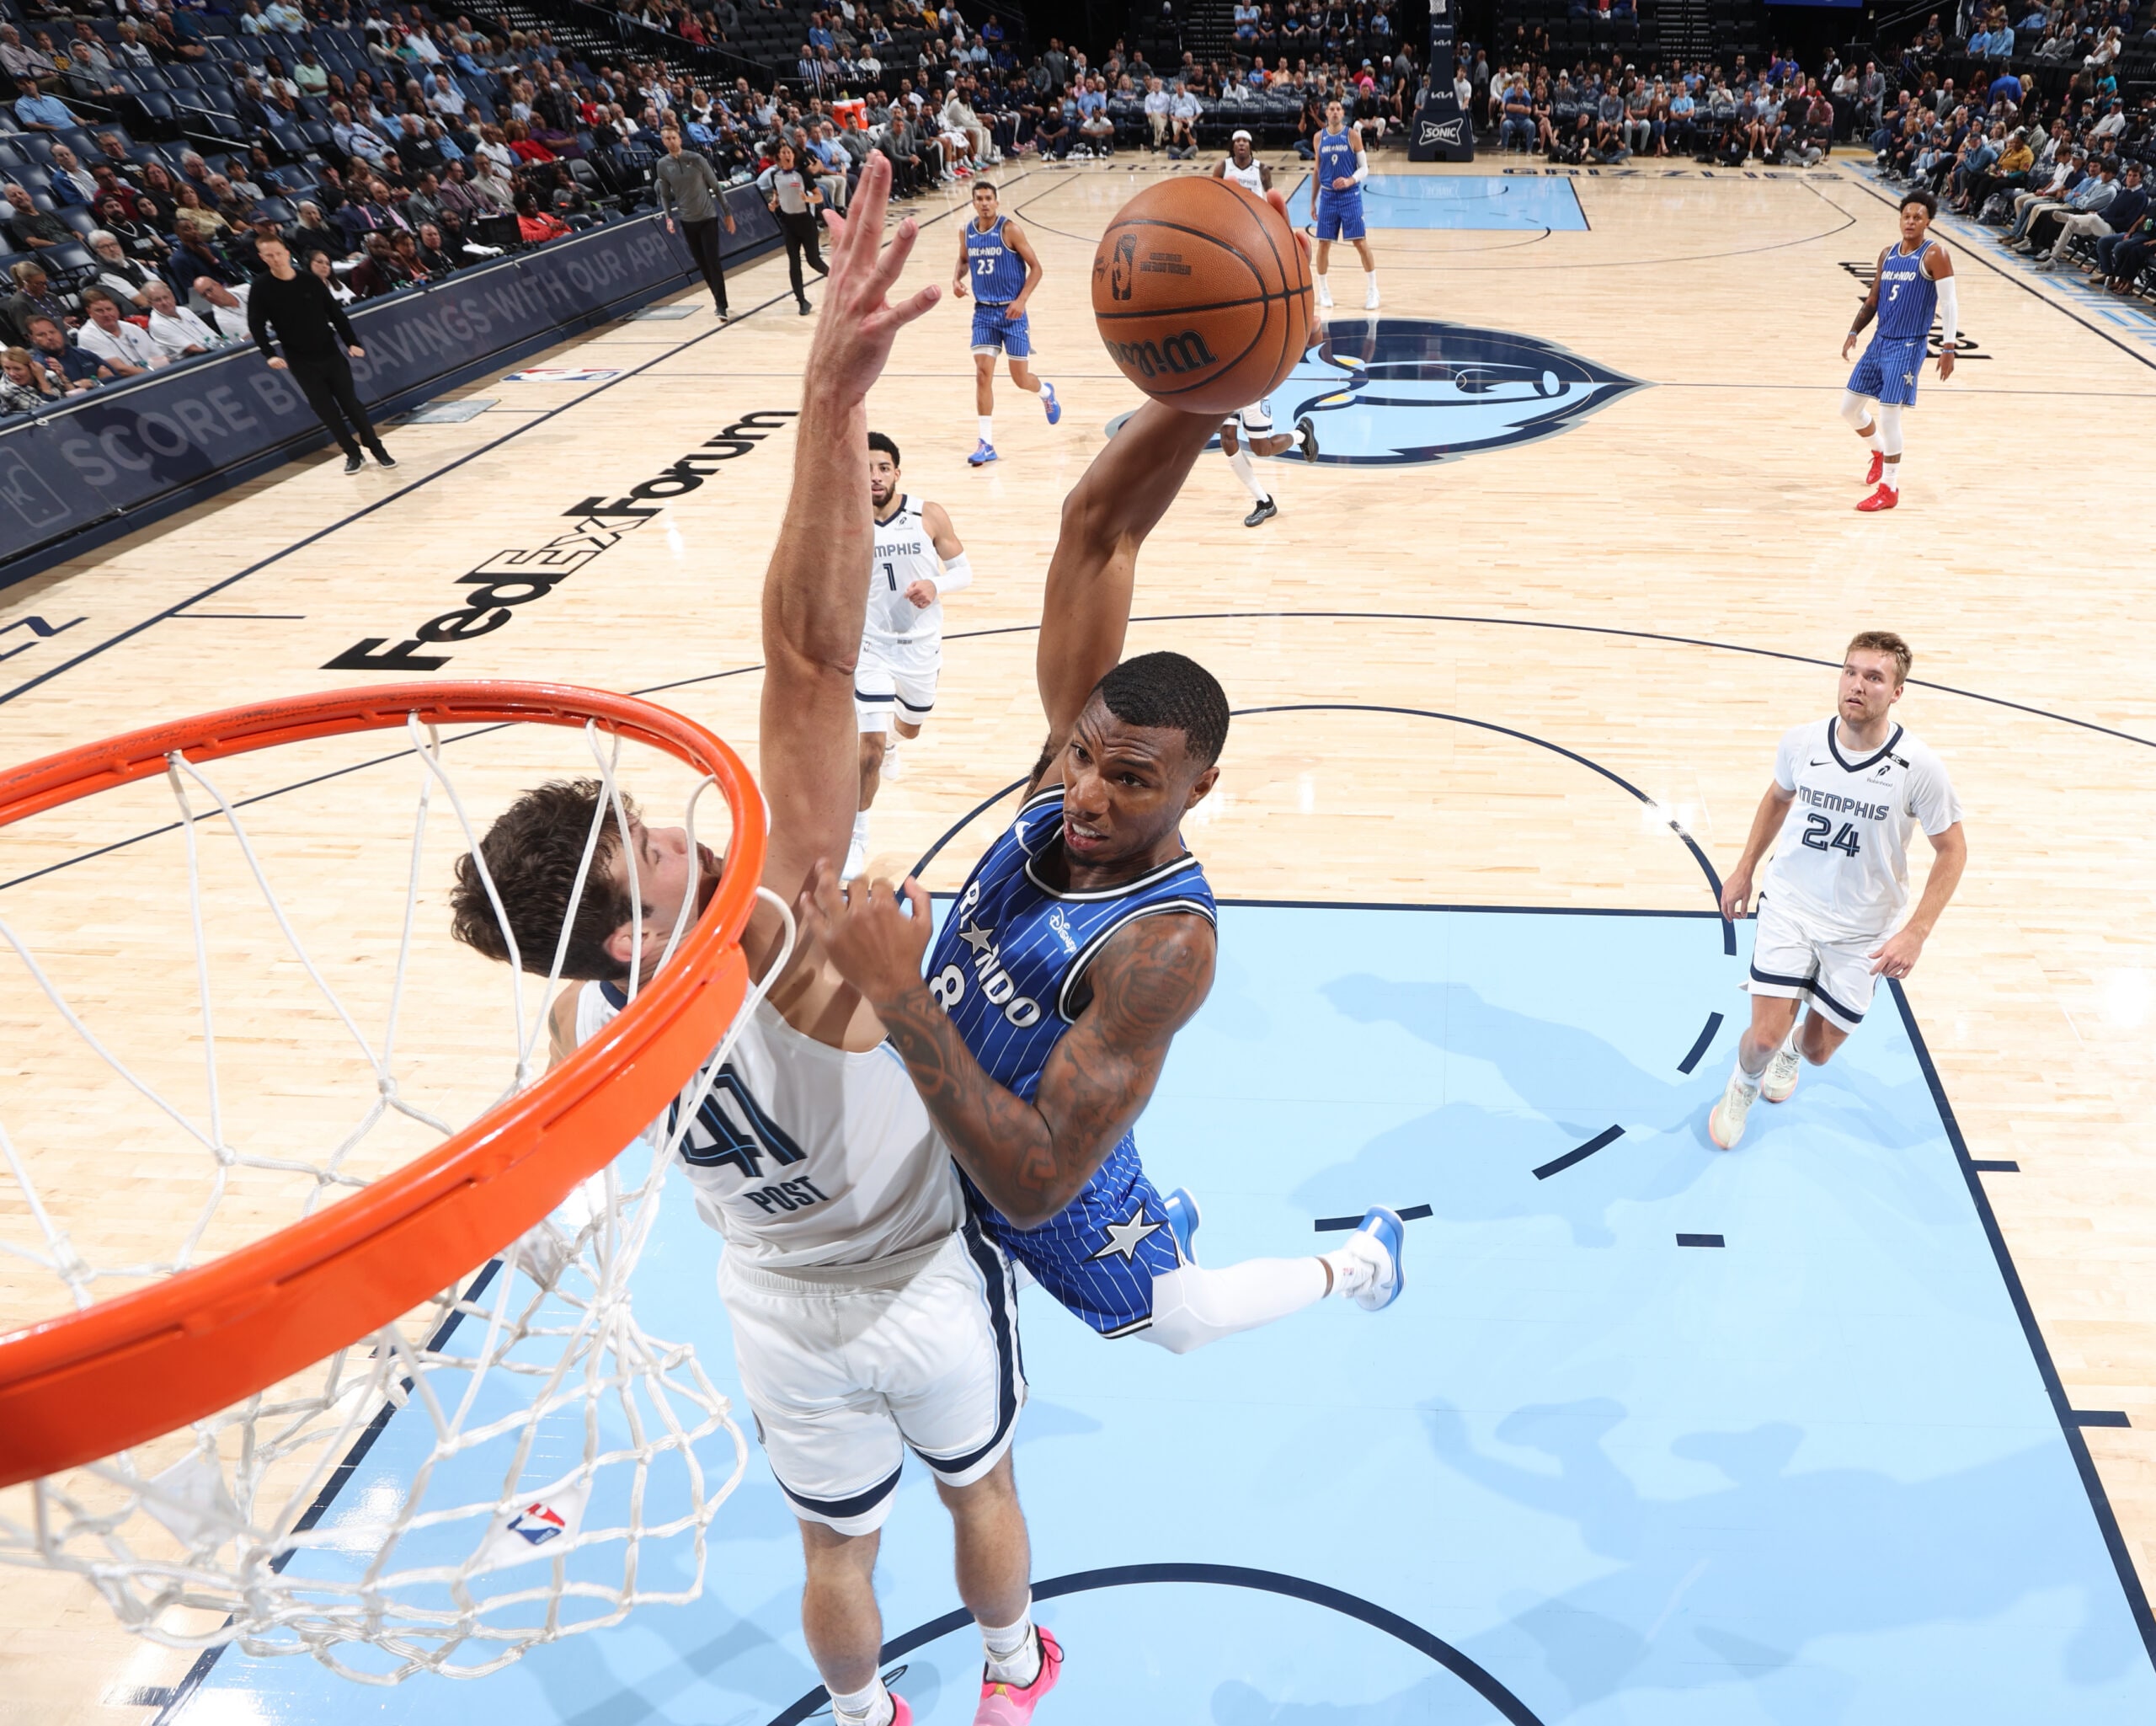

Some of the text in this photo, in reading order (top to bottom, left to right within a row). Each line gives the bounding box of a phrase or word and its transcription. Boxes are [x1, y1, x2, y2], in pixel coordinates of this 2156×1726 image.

[1425, 126, 1457, 138] SONIC
[1331, 153, 1338, 166] 9
[977, 258, 995, 275] 23
[1888, 284, 1900, 302] 5
[61, 384, 258, 487] SCORE
[484, 270, 571, 323] WITH
[566, 248, 628, 292] OUR
[626, 232, 669, 272] APP
[1105, 327, 1219, 378] Wilso
[318, 411, 799, 671] FedExForum
[874, 542, 921, 558] MPHIS
[883, 563, 897, 591] 1
[1799, 785, 1890, 821] MEMPHIS
[1801, 812, 1860, 858] 24
[667, 1063, 808, 1178] 41
[742, 1175, 830, 1214] POST
